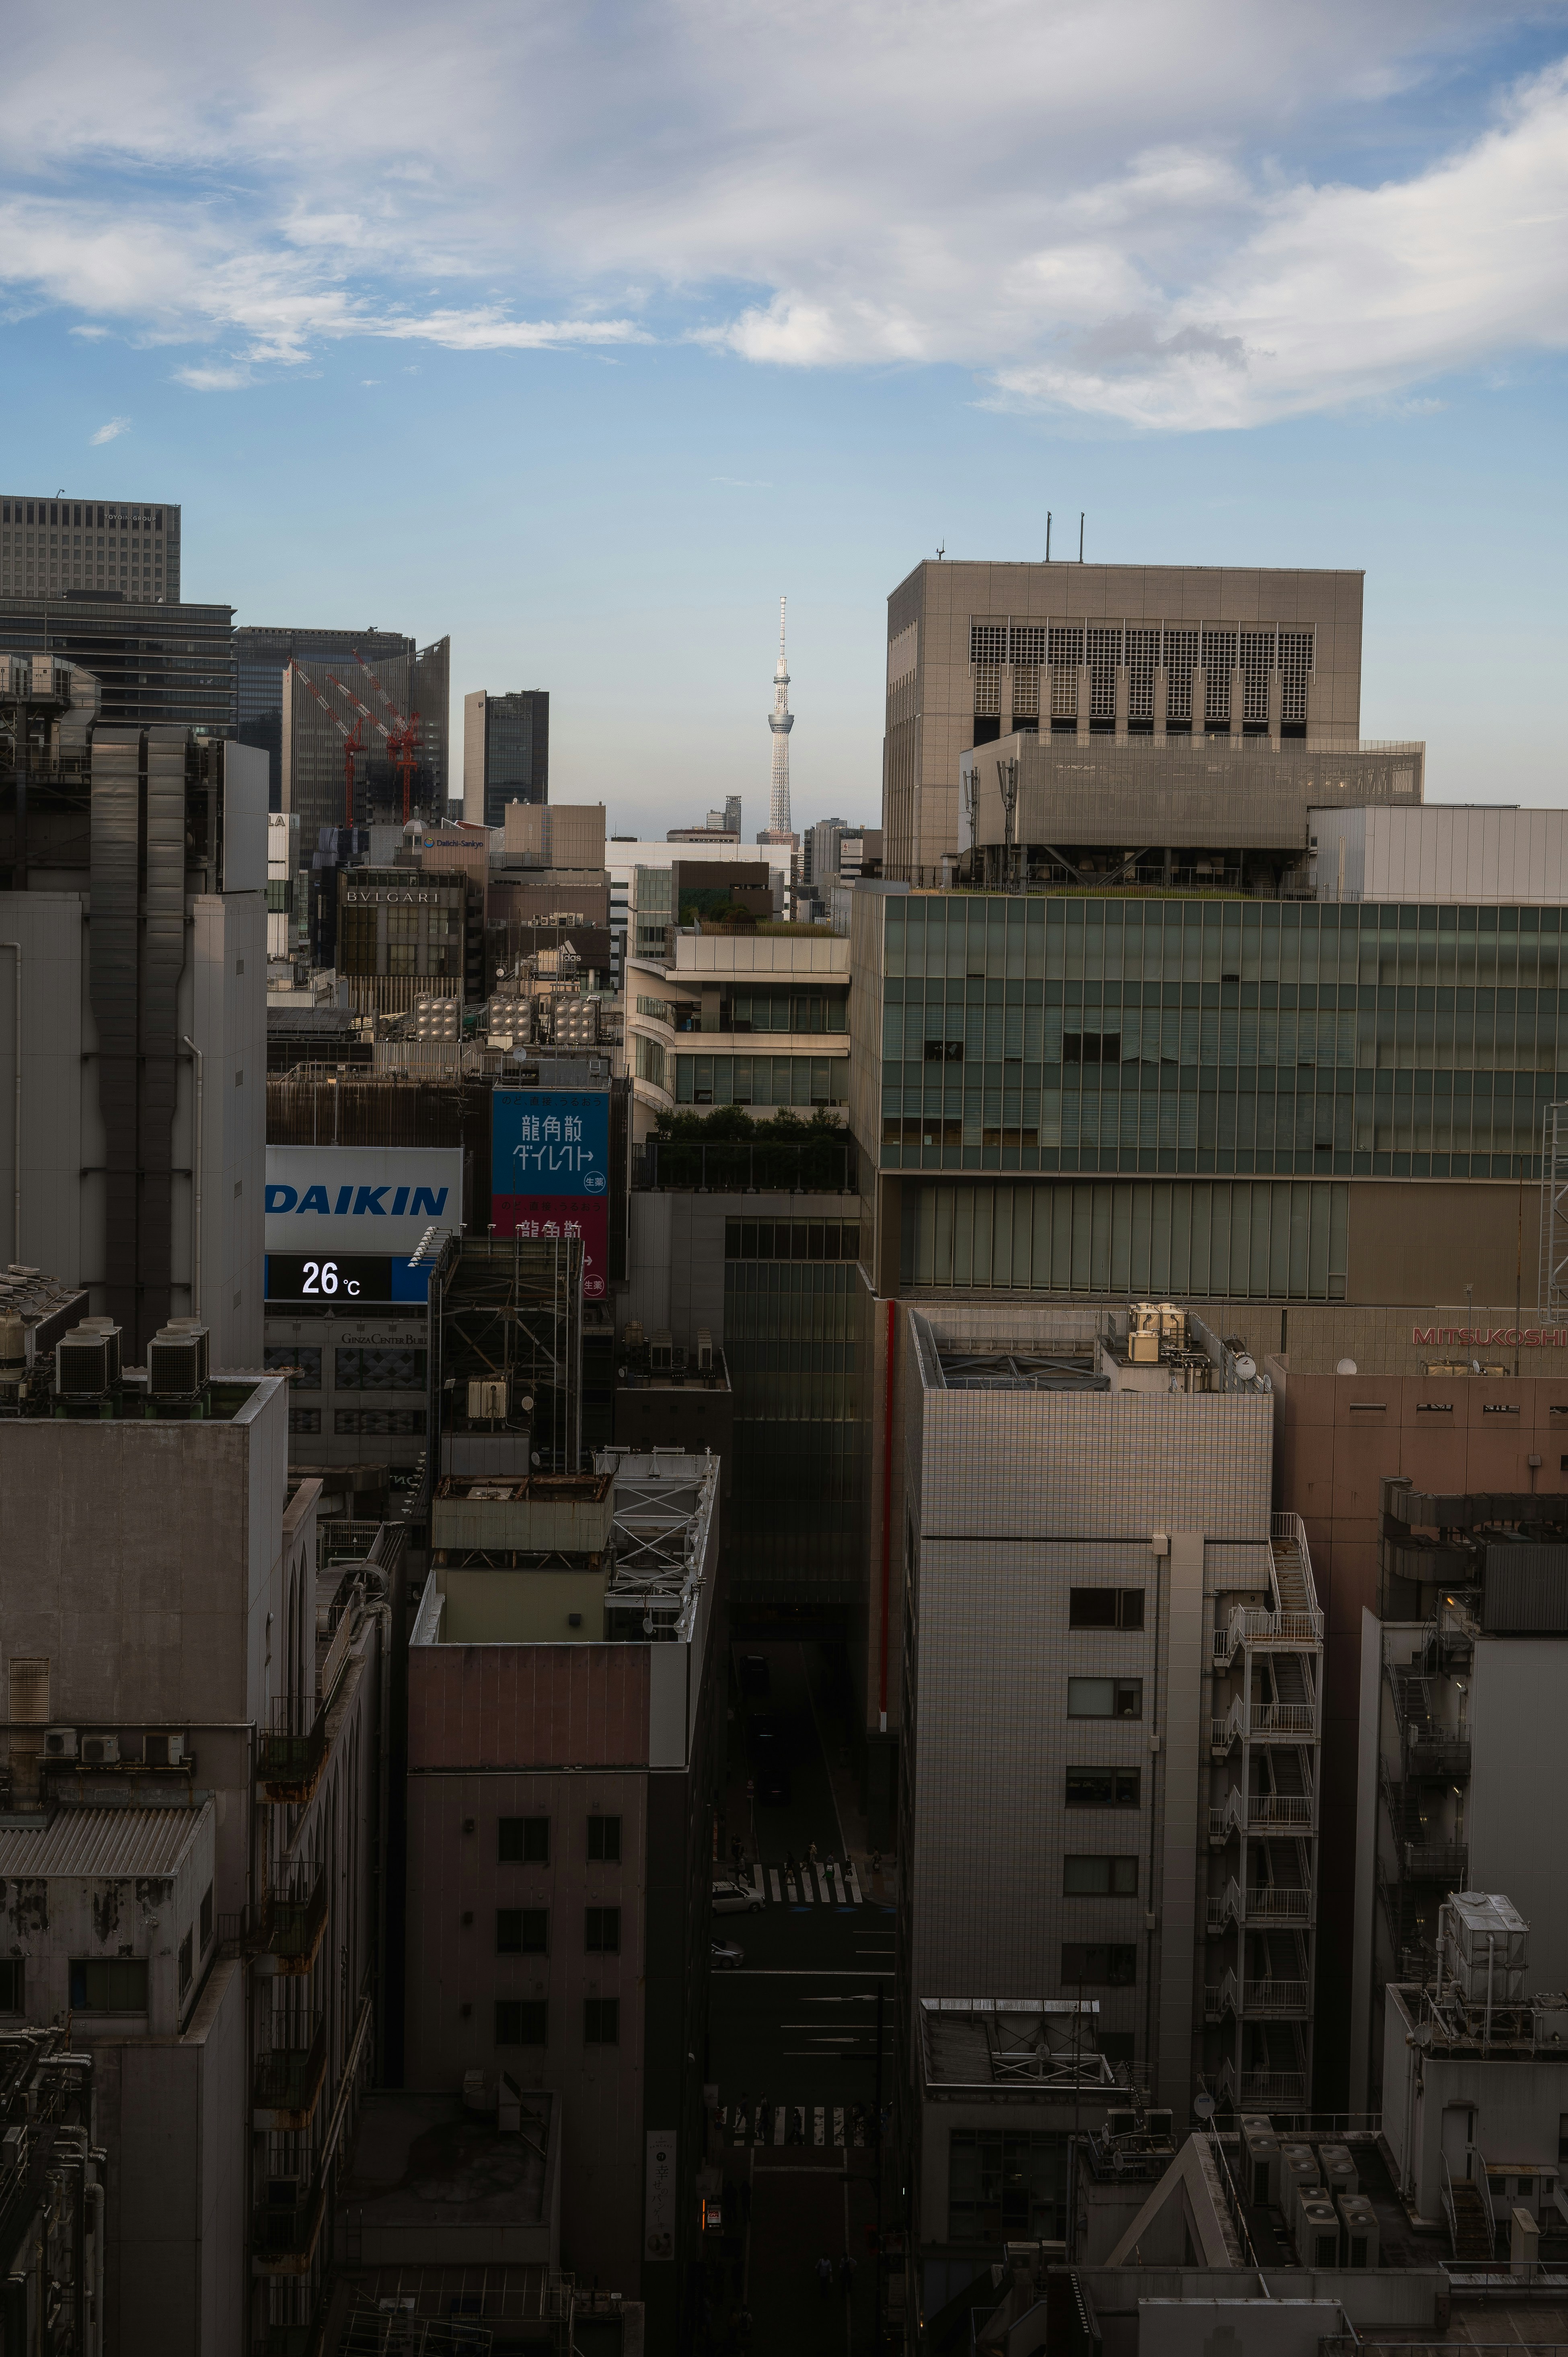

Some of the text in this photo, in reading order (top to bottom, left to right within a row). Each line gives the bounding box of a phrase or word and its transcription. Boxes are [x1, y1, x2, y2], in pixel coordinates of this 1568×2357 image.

[437, 839, 483, 849] Daiichi-Sankyo
[347, 892, 437, 902] BVLGARI
[502, 1096, 602, 1106] のど、直接、うるおう
[522, 1115, 582, 1142] 龍角散
[513, 1145, 594, 1171] ダイレクト
[586, 1177, 604, 1187] 生薬
[265, 1185, 449, 1216] DAIKIN
[501, 1201, 601, 1211] のど、直接、うるおう
[302, 1261, 338, 1294] 26
[584, 1280, 602, 1290] 生薬
[1413, 1327, 1567, 1346] MITSUKOSHI
[651, 2164, 668, 2229] 幸せのパンケーキ
